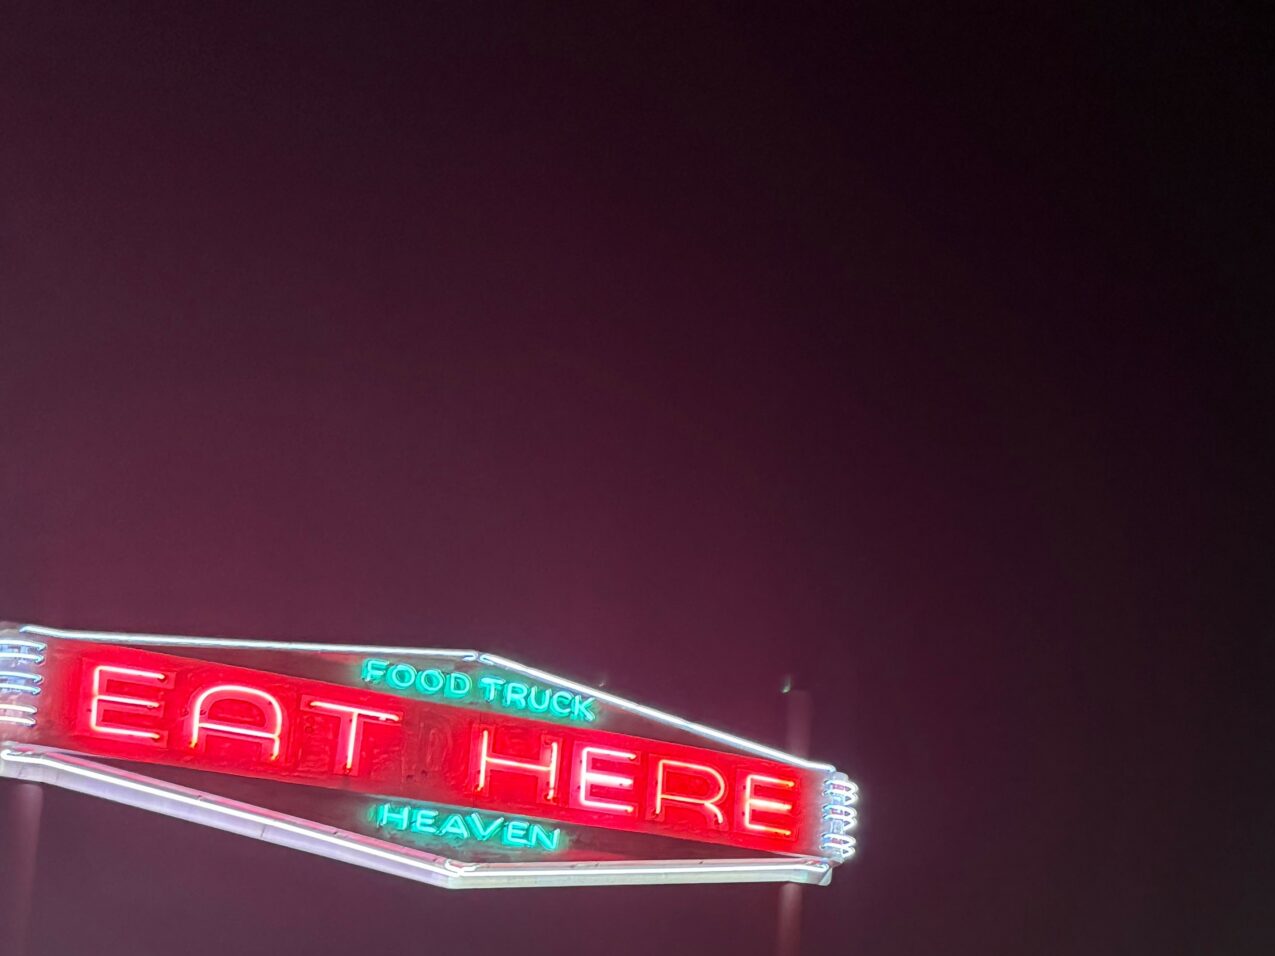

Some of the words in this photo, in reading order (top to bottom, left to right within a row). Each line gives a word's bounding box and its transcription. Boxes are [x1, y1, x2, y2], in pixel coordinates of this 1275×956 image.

[361, 658, 472, 697] FOOD
[478, 676, 596, 721] TRUCK
[87, 662, 401, 776] EAT
[472, 727, 798, 837] HERE
[377, 803, 561, 849] HEAVEN
